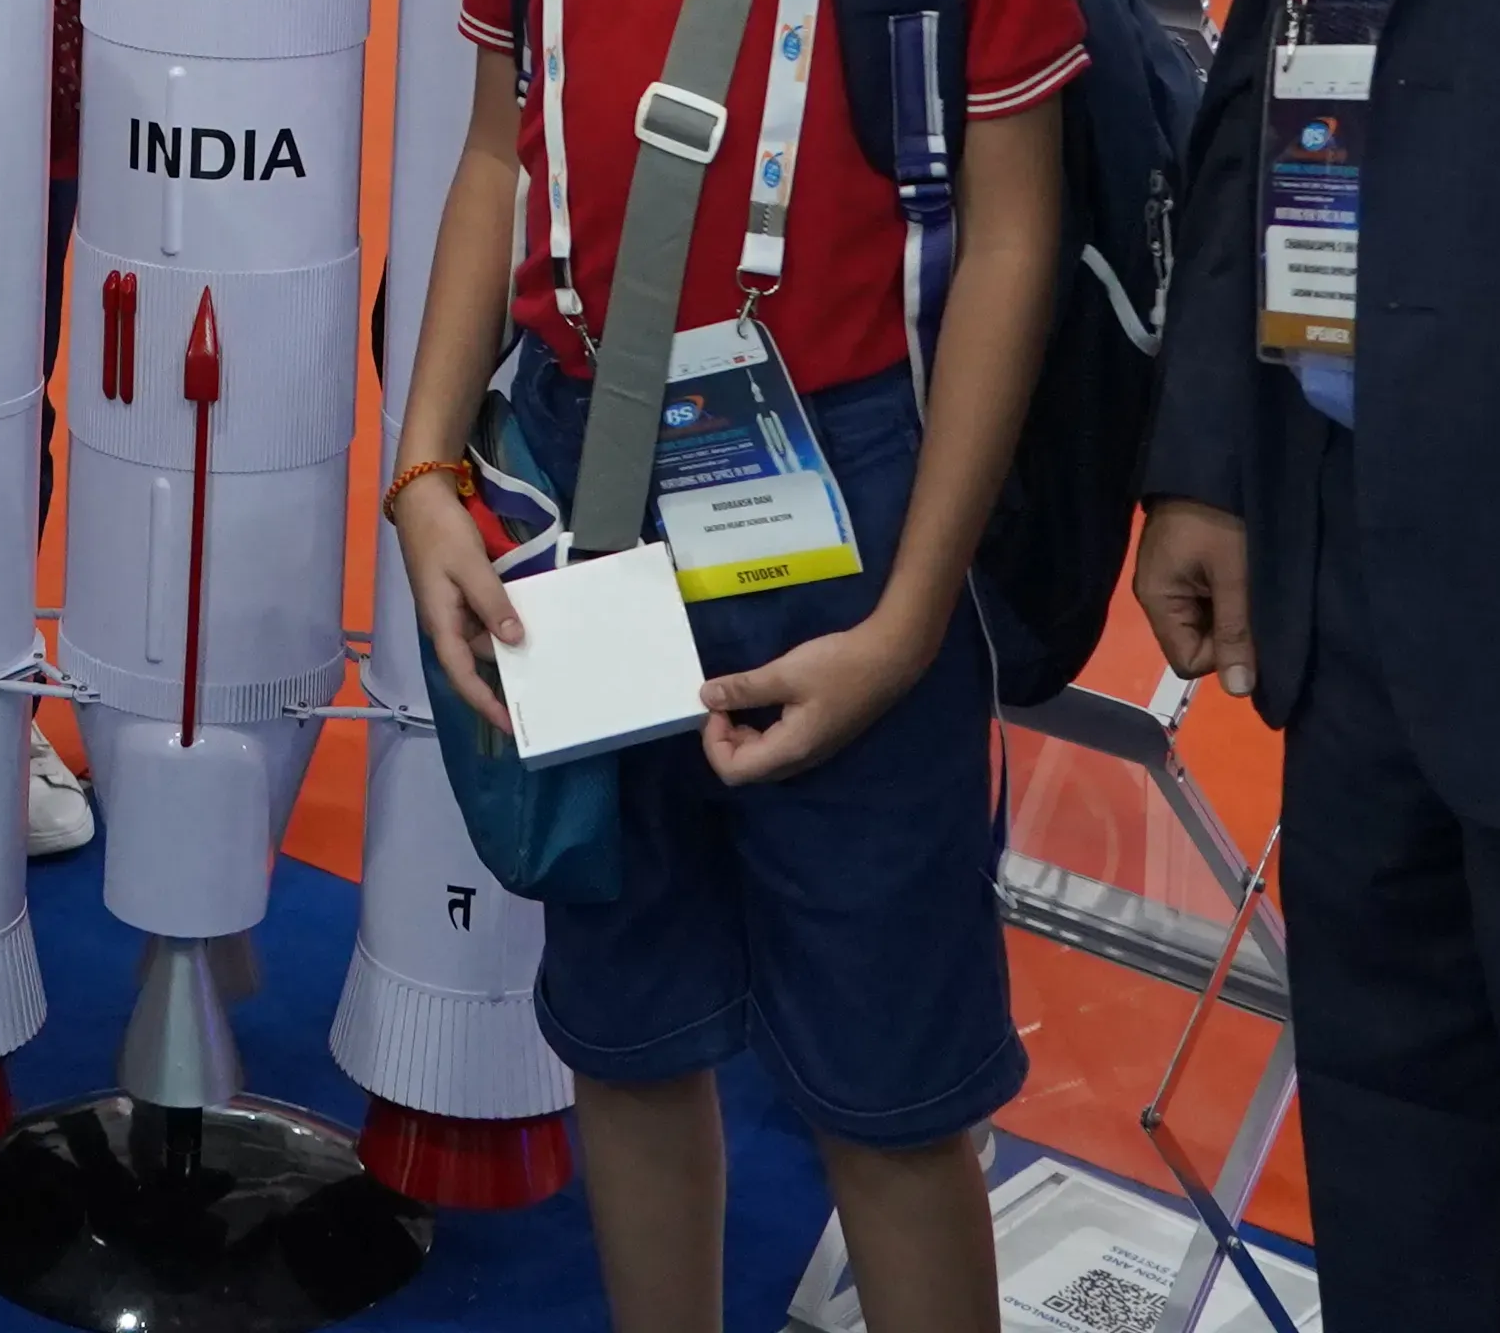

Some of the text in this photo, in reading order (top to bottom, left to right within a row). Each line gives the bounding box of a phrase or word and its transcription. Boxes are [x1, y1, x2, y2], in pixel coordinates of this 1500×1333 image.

[127, 118, 307, 183] INDIA
[735, 563, 791, 584] STUDENT
[1101, 1253, 1136, 1272] AND
[1109, 1244, 1171, 1275] SYSTEMS
